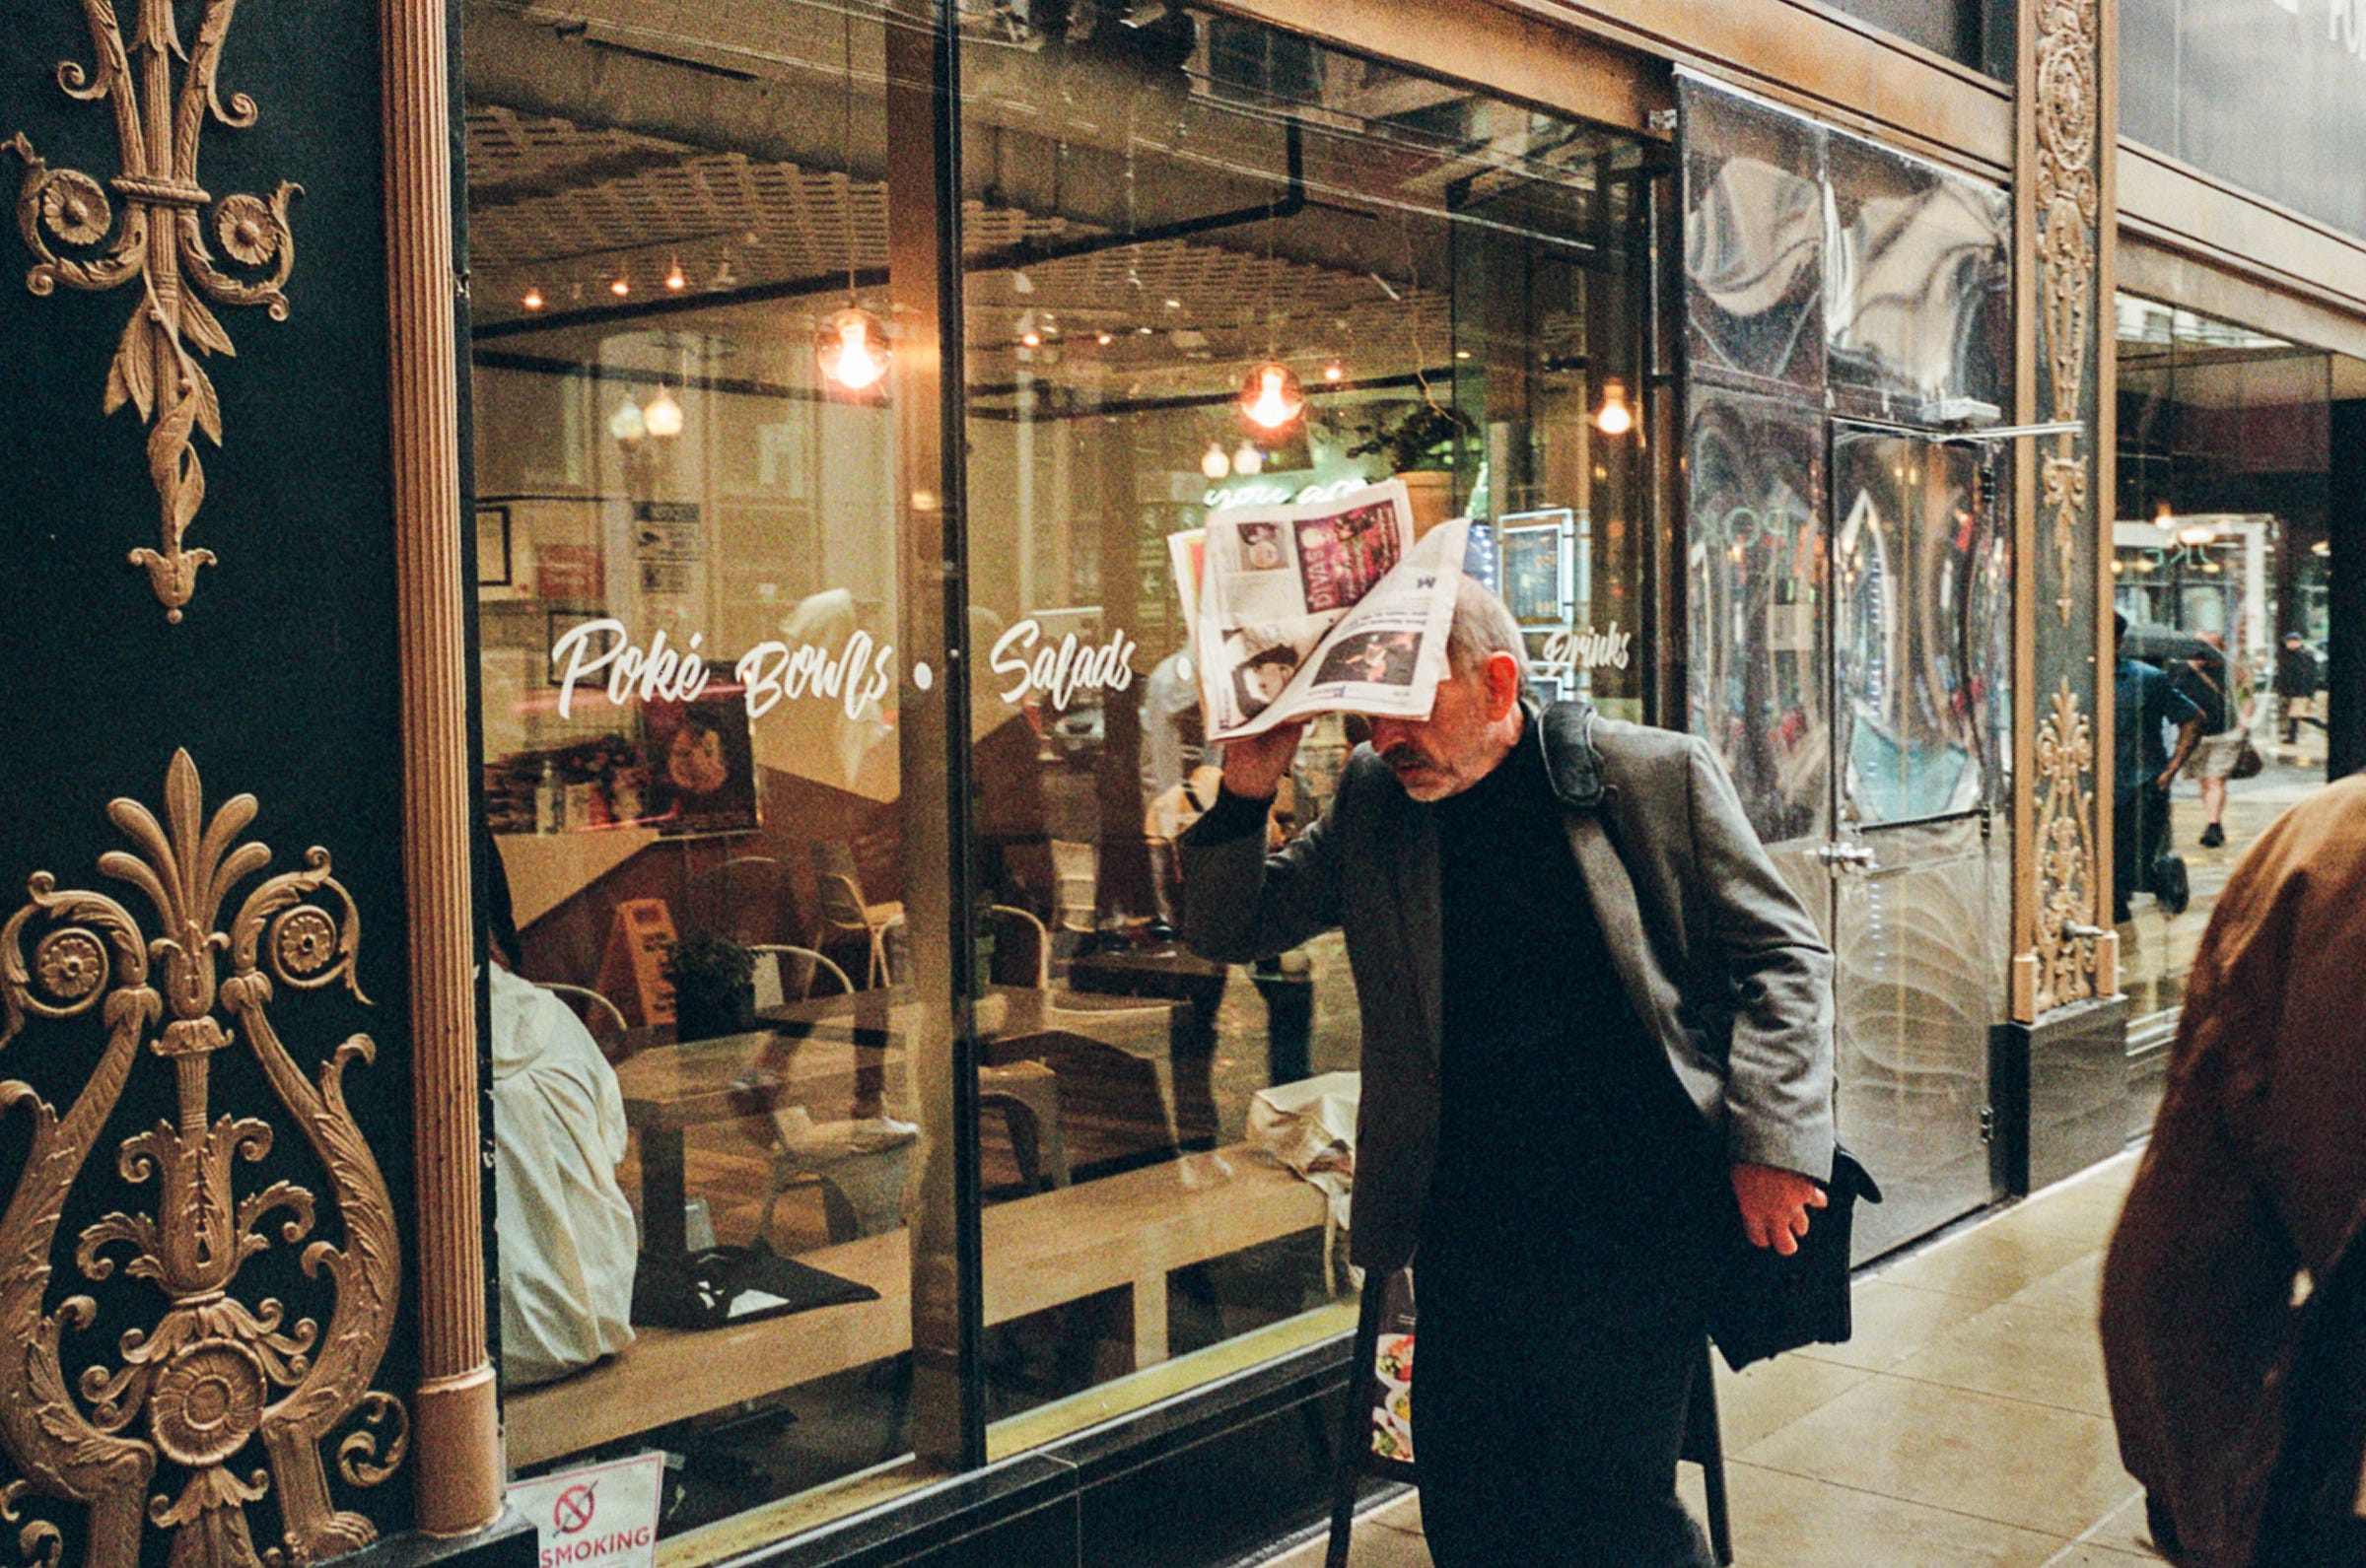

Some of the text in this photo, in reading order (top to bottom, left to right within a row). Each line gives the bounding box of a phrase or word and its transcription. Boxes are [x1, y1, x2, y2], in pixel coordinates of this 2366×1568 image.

[552, 618, 710, 719] Poké
[735, 629, 893, 719] Bowls
[990, 619, 1137, 712] Salads
[1543, 620, 1632, 678] Drinks
[539, 1526, 651, 1568] SMOKING
